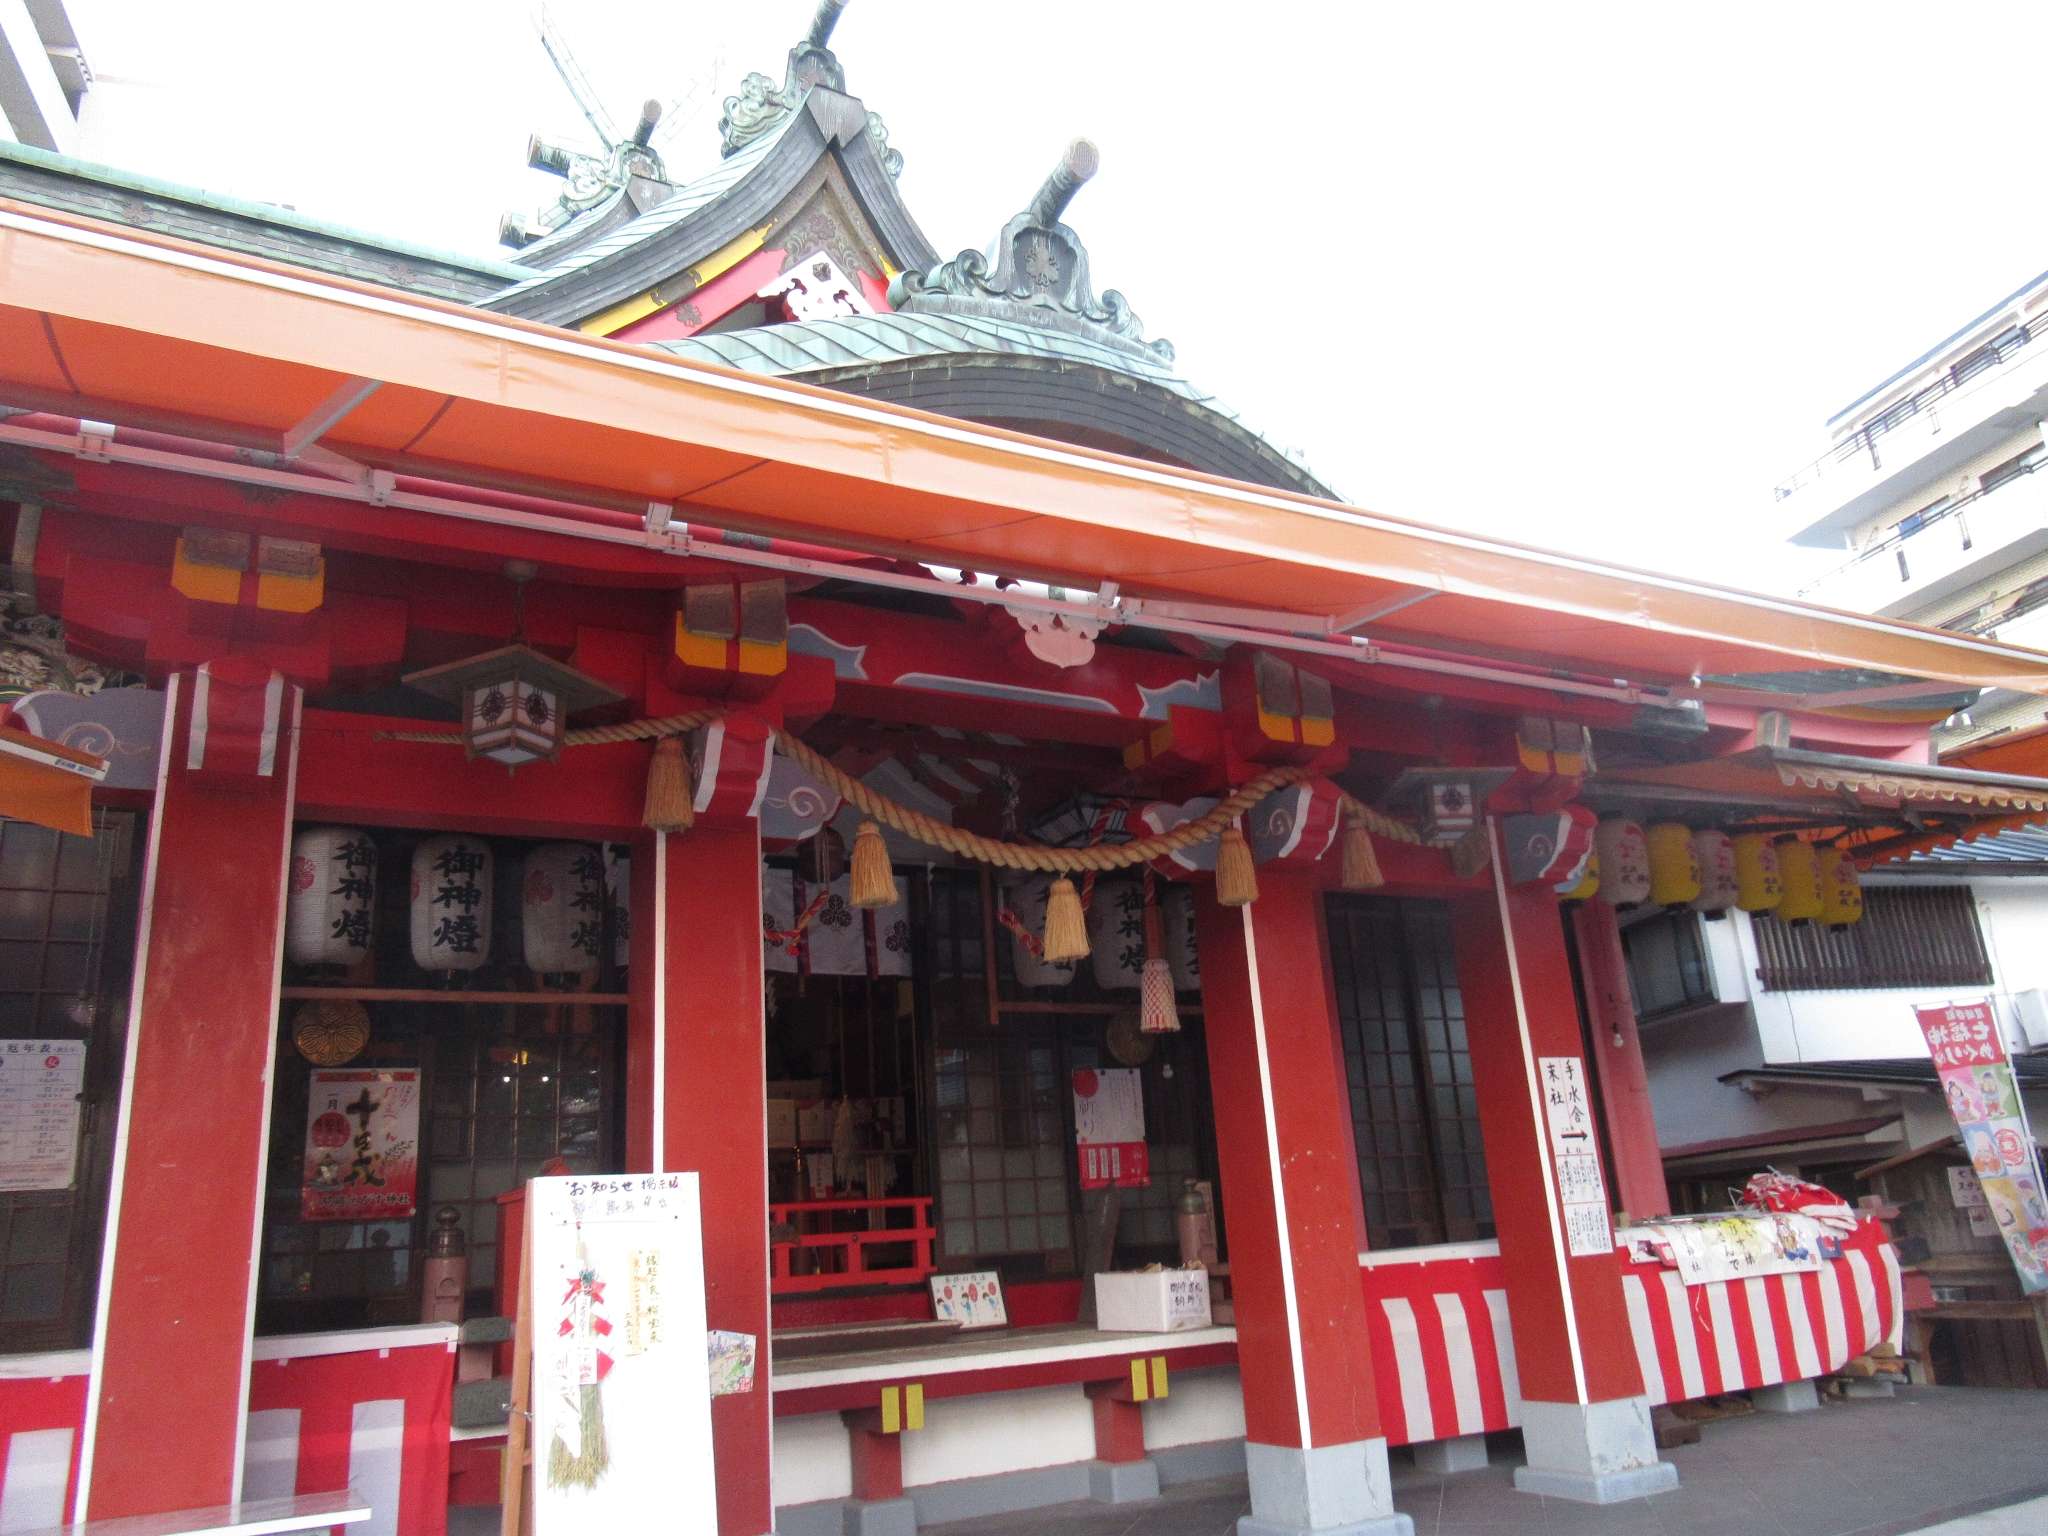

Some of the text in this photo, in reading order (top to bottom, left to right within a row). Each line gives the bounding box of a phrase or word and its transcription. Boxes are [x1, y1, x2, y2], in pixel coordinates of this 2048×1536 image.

[432, 844, 484, 953] 御神燈
[569, 1181, 633, 1197] お知らせ
